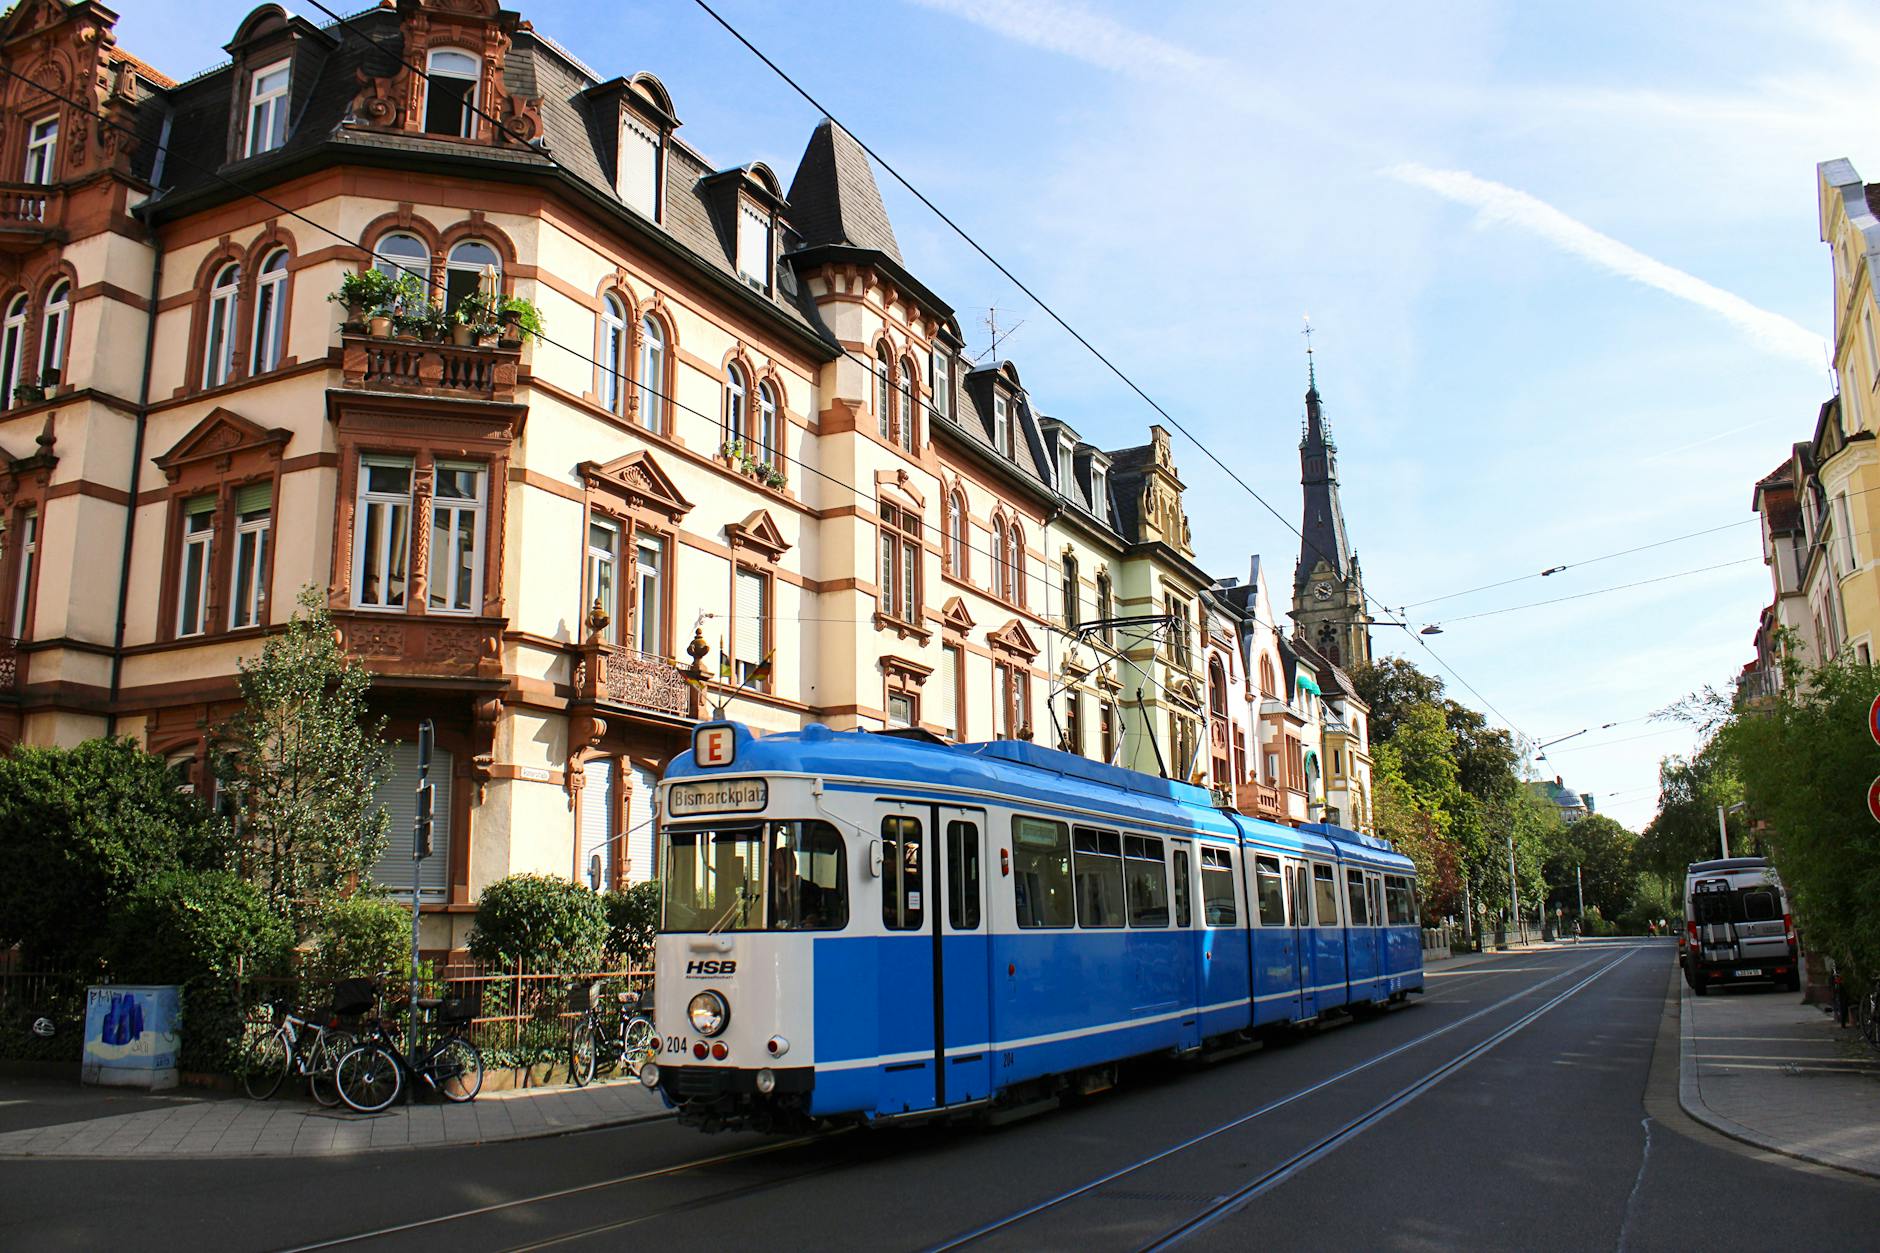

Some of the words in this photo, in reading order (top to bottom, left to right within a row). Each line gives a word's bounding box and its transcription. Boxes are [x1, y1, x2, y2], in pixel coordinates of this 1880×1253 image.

[709, 733, 722, 761] E
[675, 787, 767, 807] Bismarckplatz
[686, 960, 737, 975] HSB
[667, 1036, 687, 1054] 204
